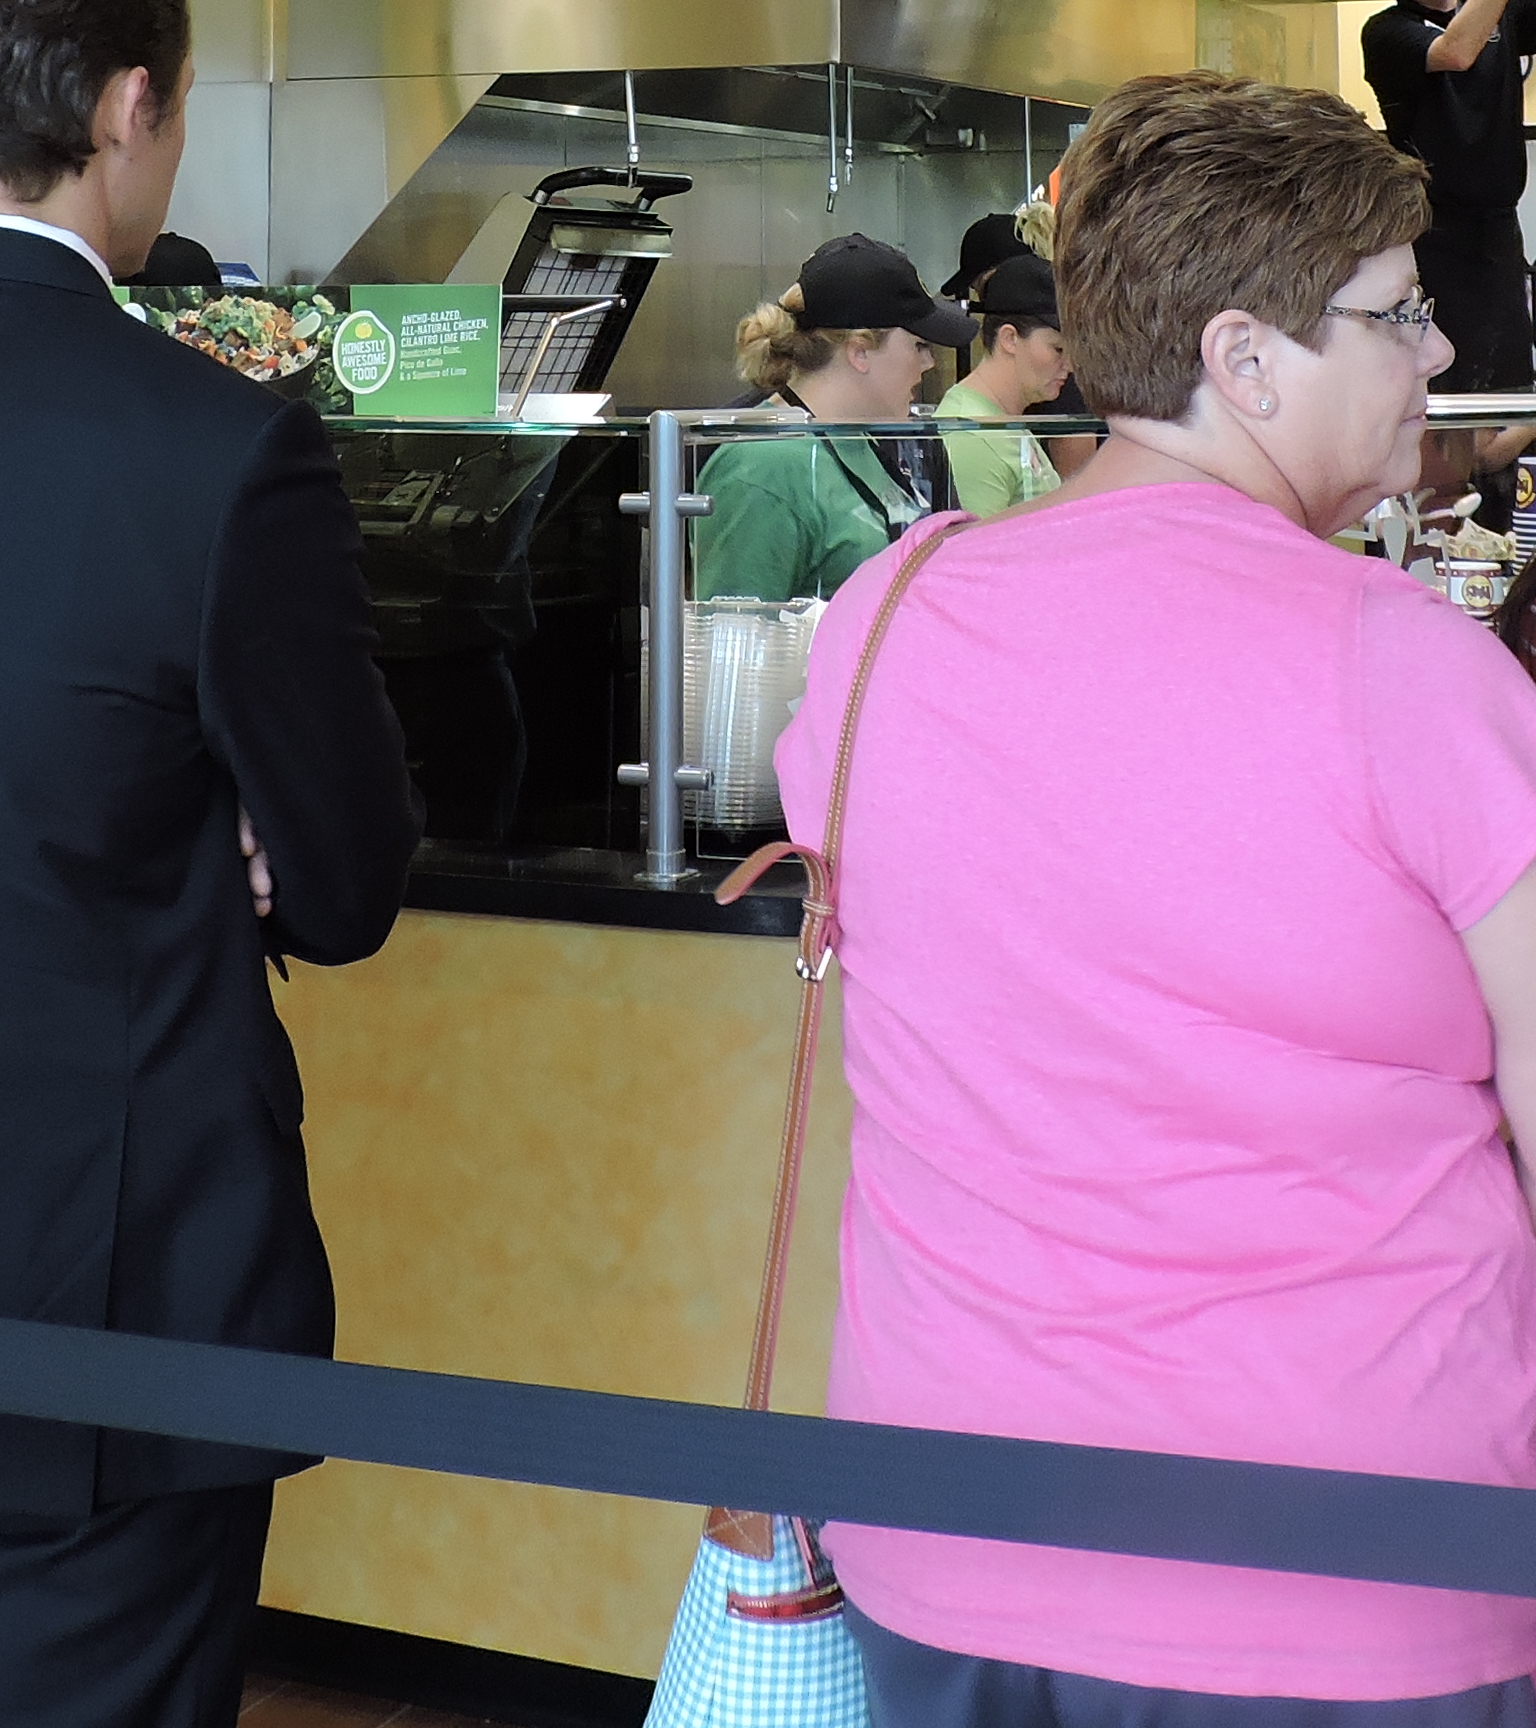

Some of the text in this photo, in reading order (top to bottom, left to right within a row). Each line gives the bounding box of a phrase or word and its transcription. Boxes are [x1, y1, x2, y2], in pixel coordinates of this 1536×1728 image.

[401, 318, 489, 337] ALL-NATURAL CHICKEN,
[341, 339, 386, 356] HONESTLY
[401, 333, 438, 348] CILANTRO
[341, 351, 387, 369] AWESOME
[351, 366, 378, 382] FOOD
